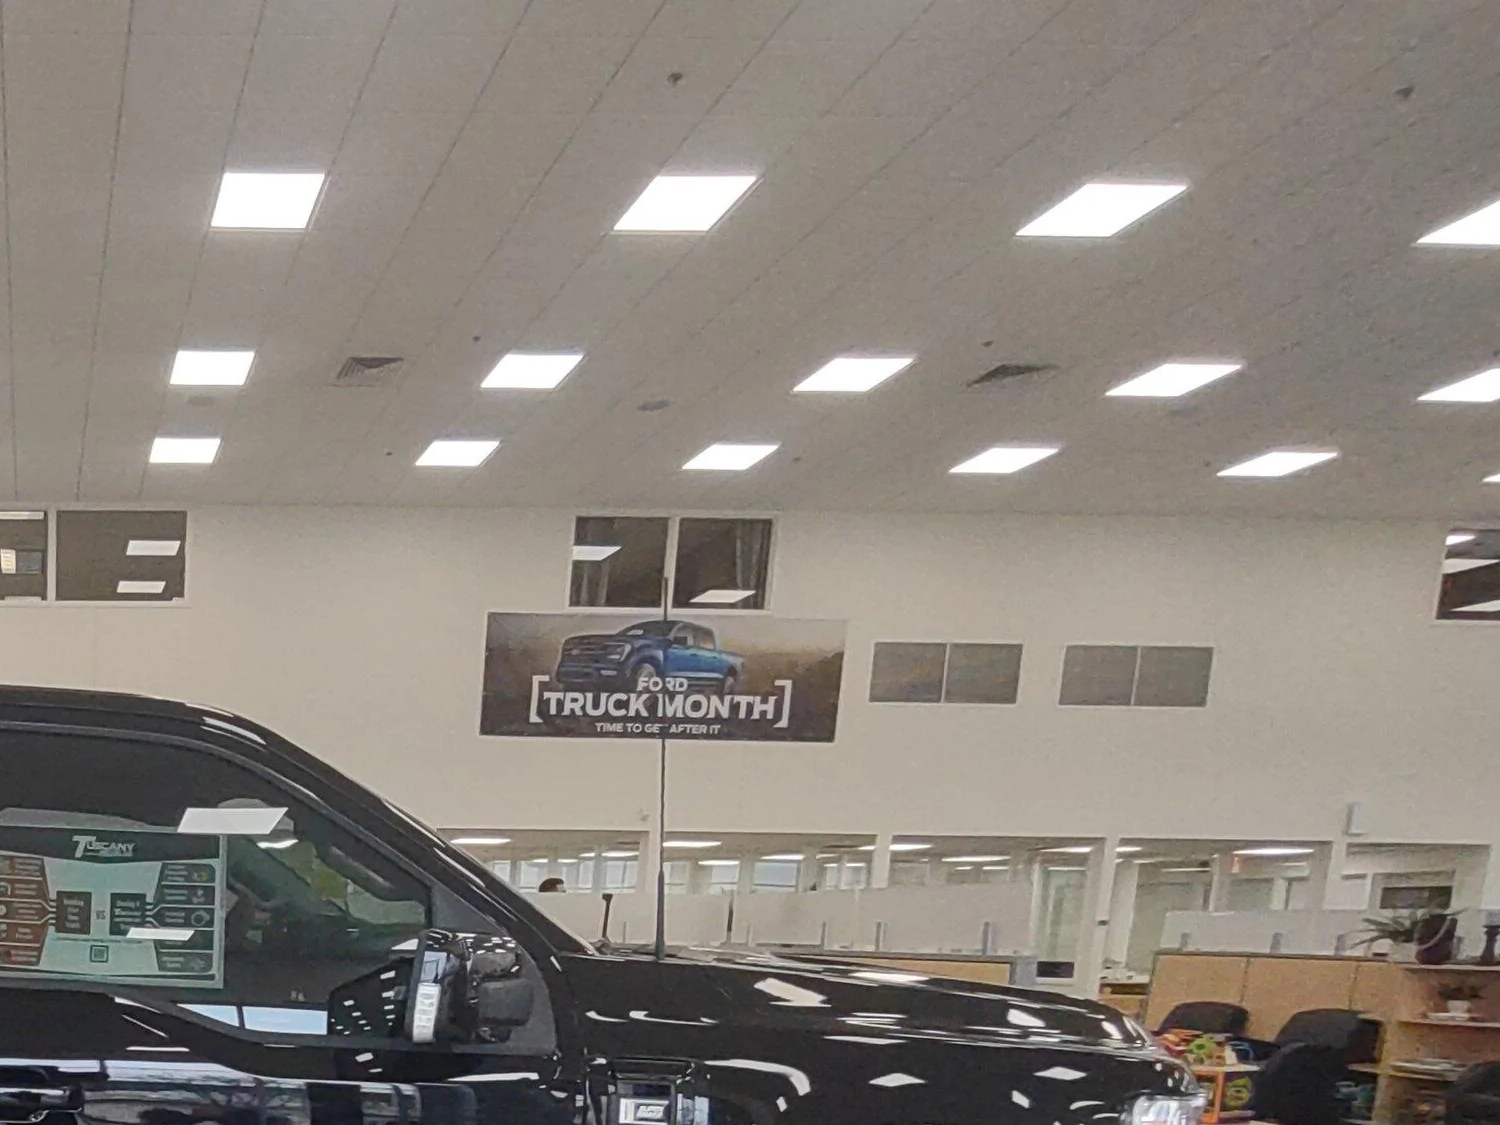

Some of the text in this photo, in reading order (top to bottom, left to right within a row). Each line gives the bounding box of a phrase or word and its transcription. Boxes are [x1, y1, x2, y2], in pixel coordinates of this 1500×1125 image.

[636, 677, 688, 692] FORD
[543, 691, 778, 720] TRUCK MONTH
[595, 722, 624, 733] TIME
[625, 723, 642, 733] TO
[669, 724, 707, 735] AFTER
[709, 724, 721, 735] IT
